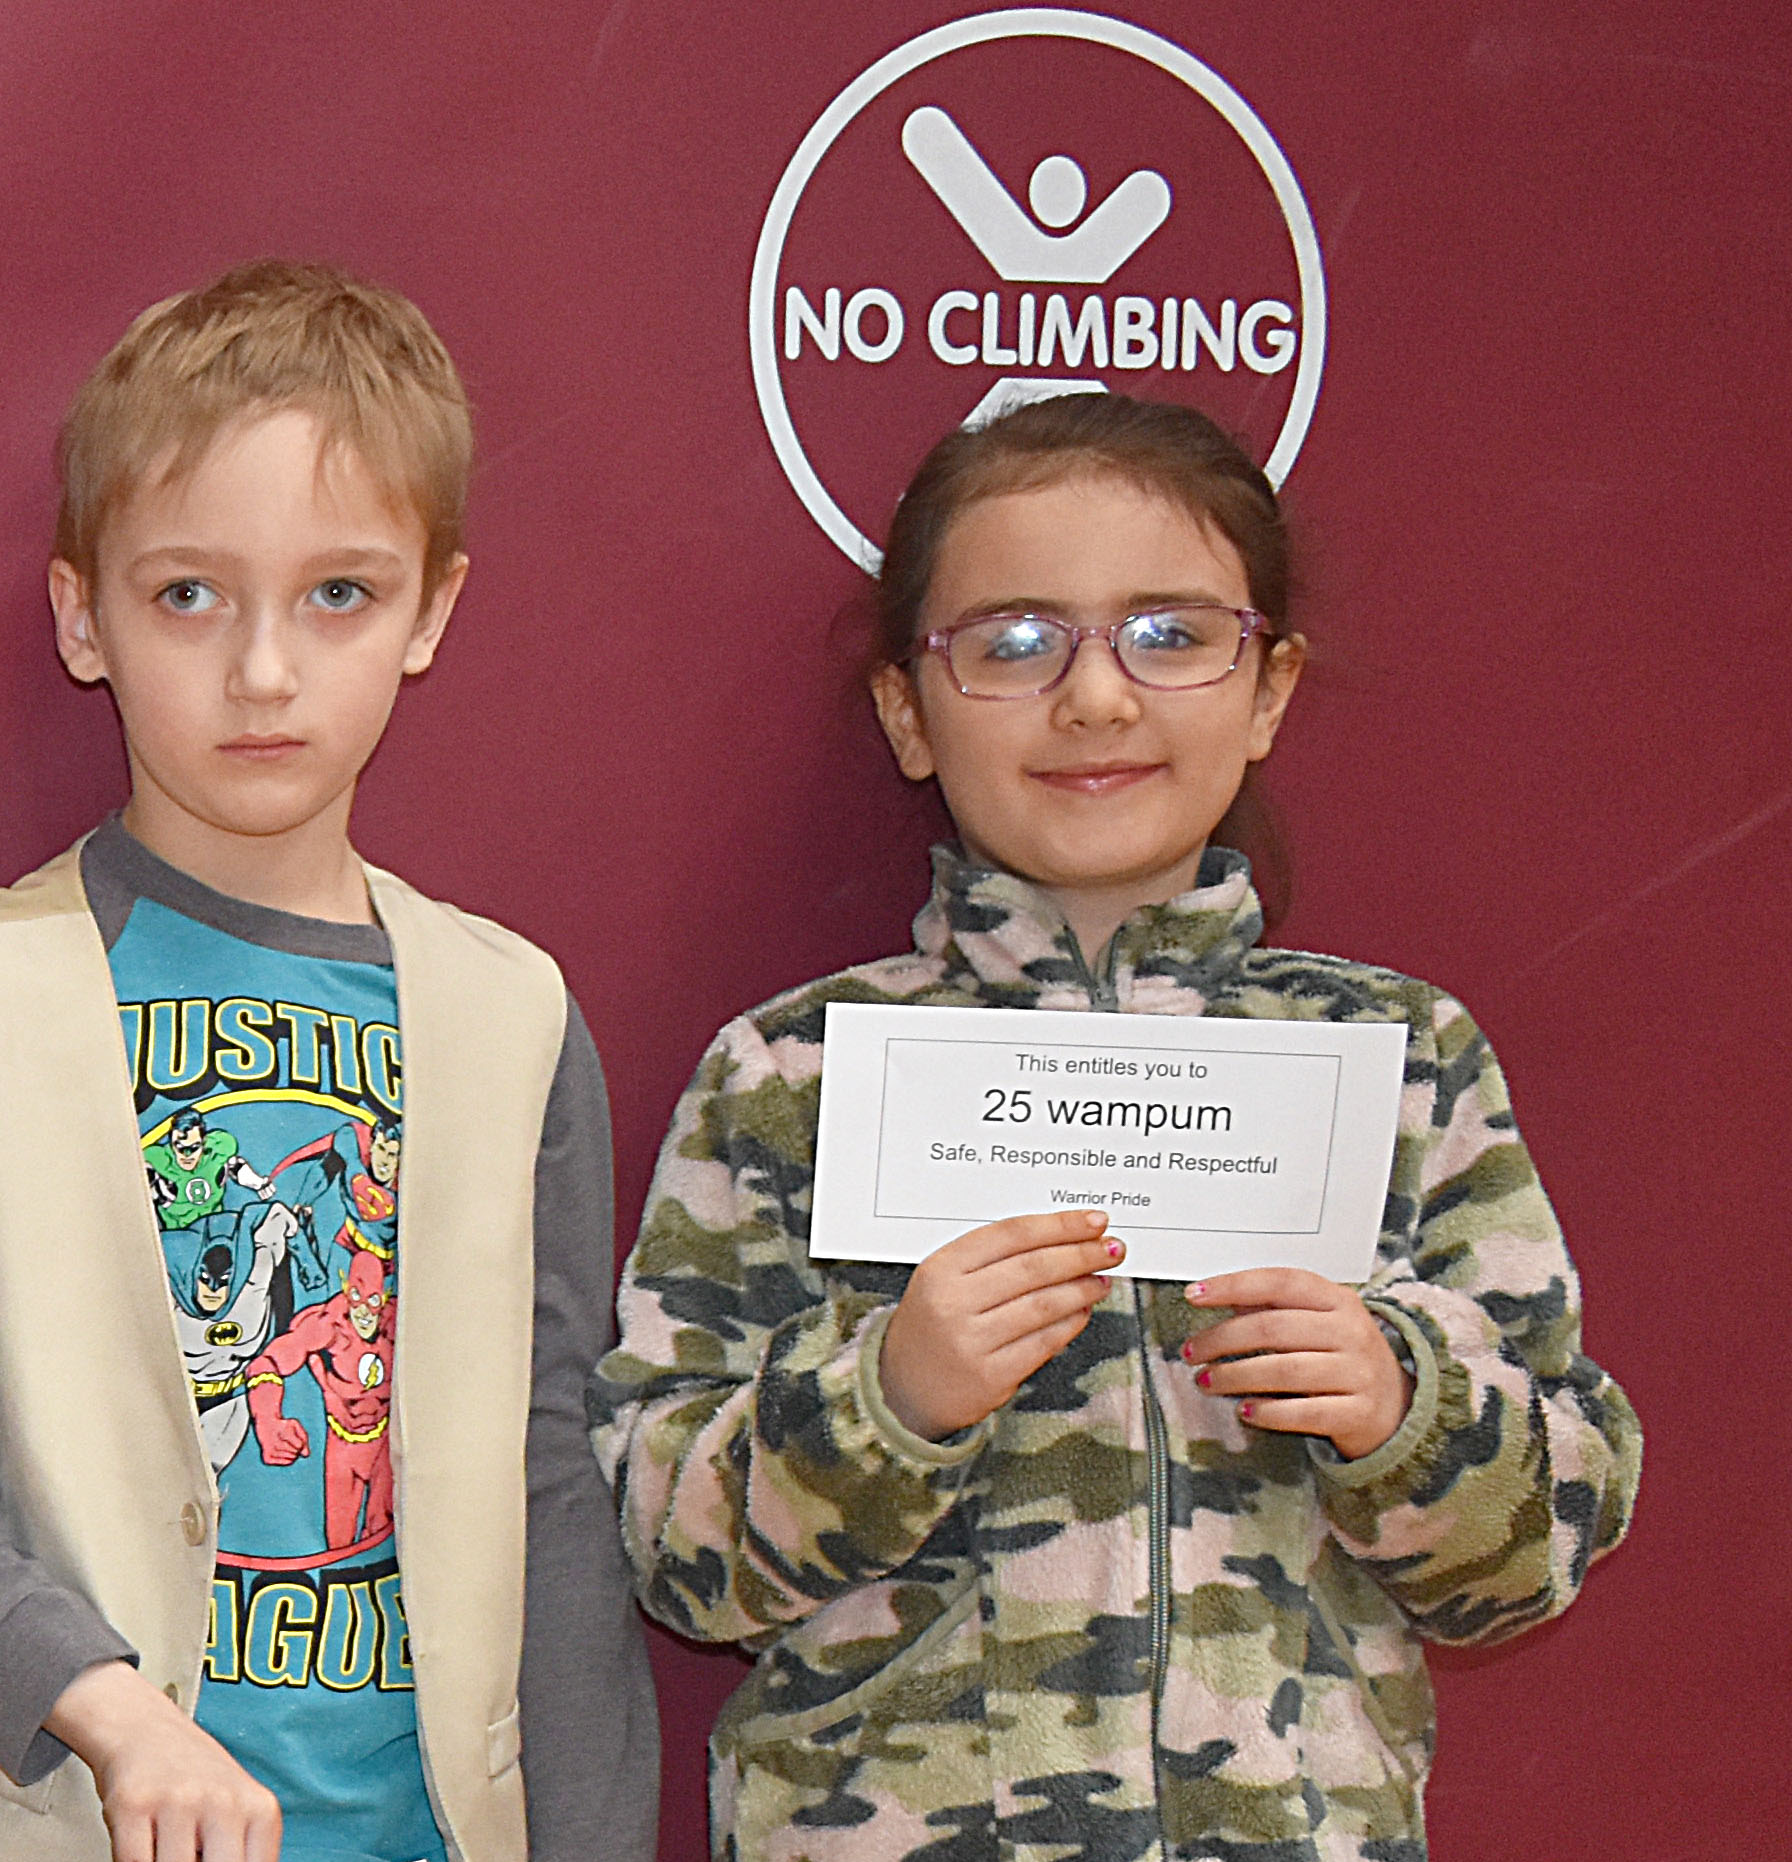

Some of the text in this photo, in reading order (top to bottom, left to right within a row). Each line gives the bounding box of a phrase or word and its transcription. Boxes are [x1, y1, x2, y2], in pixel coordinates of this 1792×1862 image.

[785, 287, 1297, 374] NO CLIMBING
[1016, 1053, 1208, 1080] This entitles you to
[982, 1088, 1233, 1136] 25 wampum
[930, 1142, 1278, 1176] Safe, Responsible and Respectful
[1050, 1189, 1151, 1207] Warrior Pride
